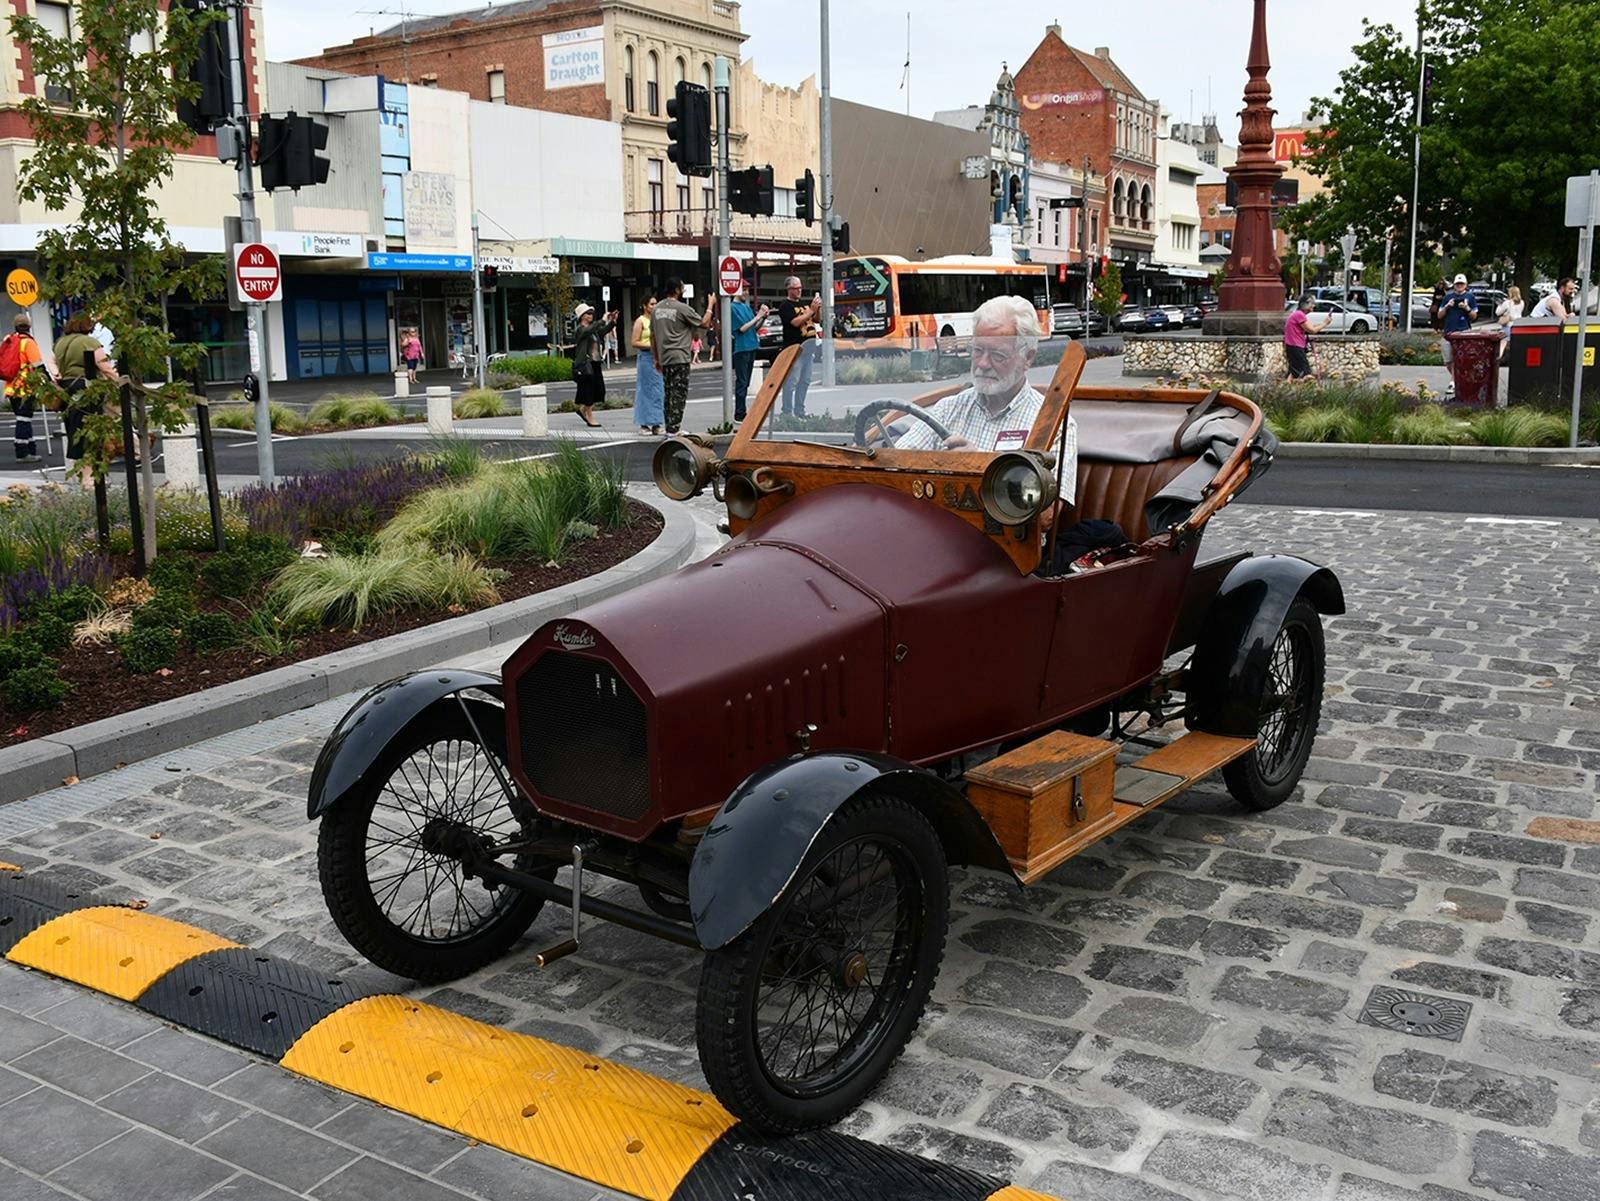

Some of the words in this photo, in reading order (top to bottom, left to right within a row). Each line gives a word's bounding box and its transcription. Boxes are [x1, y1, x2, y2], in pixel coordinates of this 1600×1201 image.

[551, 51, 599, 66] Carlton
[550, 64, 600, 81] Draught
[1052, 94, 1078, 105] Origin
[412, 173, 448, 191] OPEN
[420, 189, 454, 206] DAYS
[314, 236, 336, 246] People
[336, 237, 351, 246] First
[314, 245, 331, 253] Bank
[250, 253, 265, 265] NO
[726, 262, 735, 271] NO
[8, 280, 36, 295] SLOW
[243, 280, 275, 292] ENTRY
[723, 280, 739, 289] ENTRY
[553, 624, 597, 650] Humber
